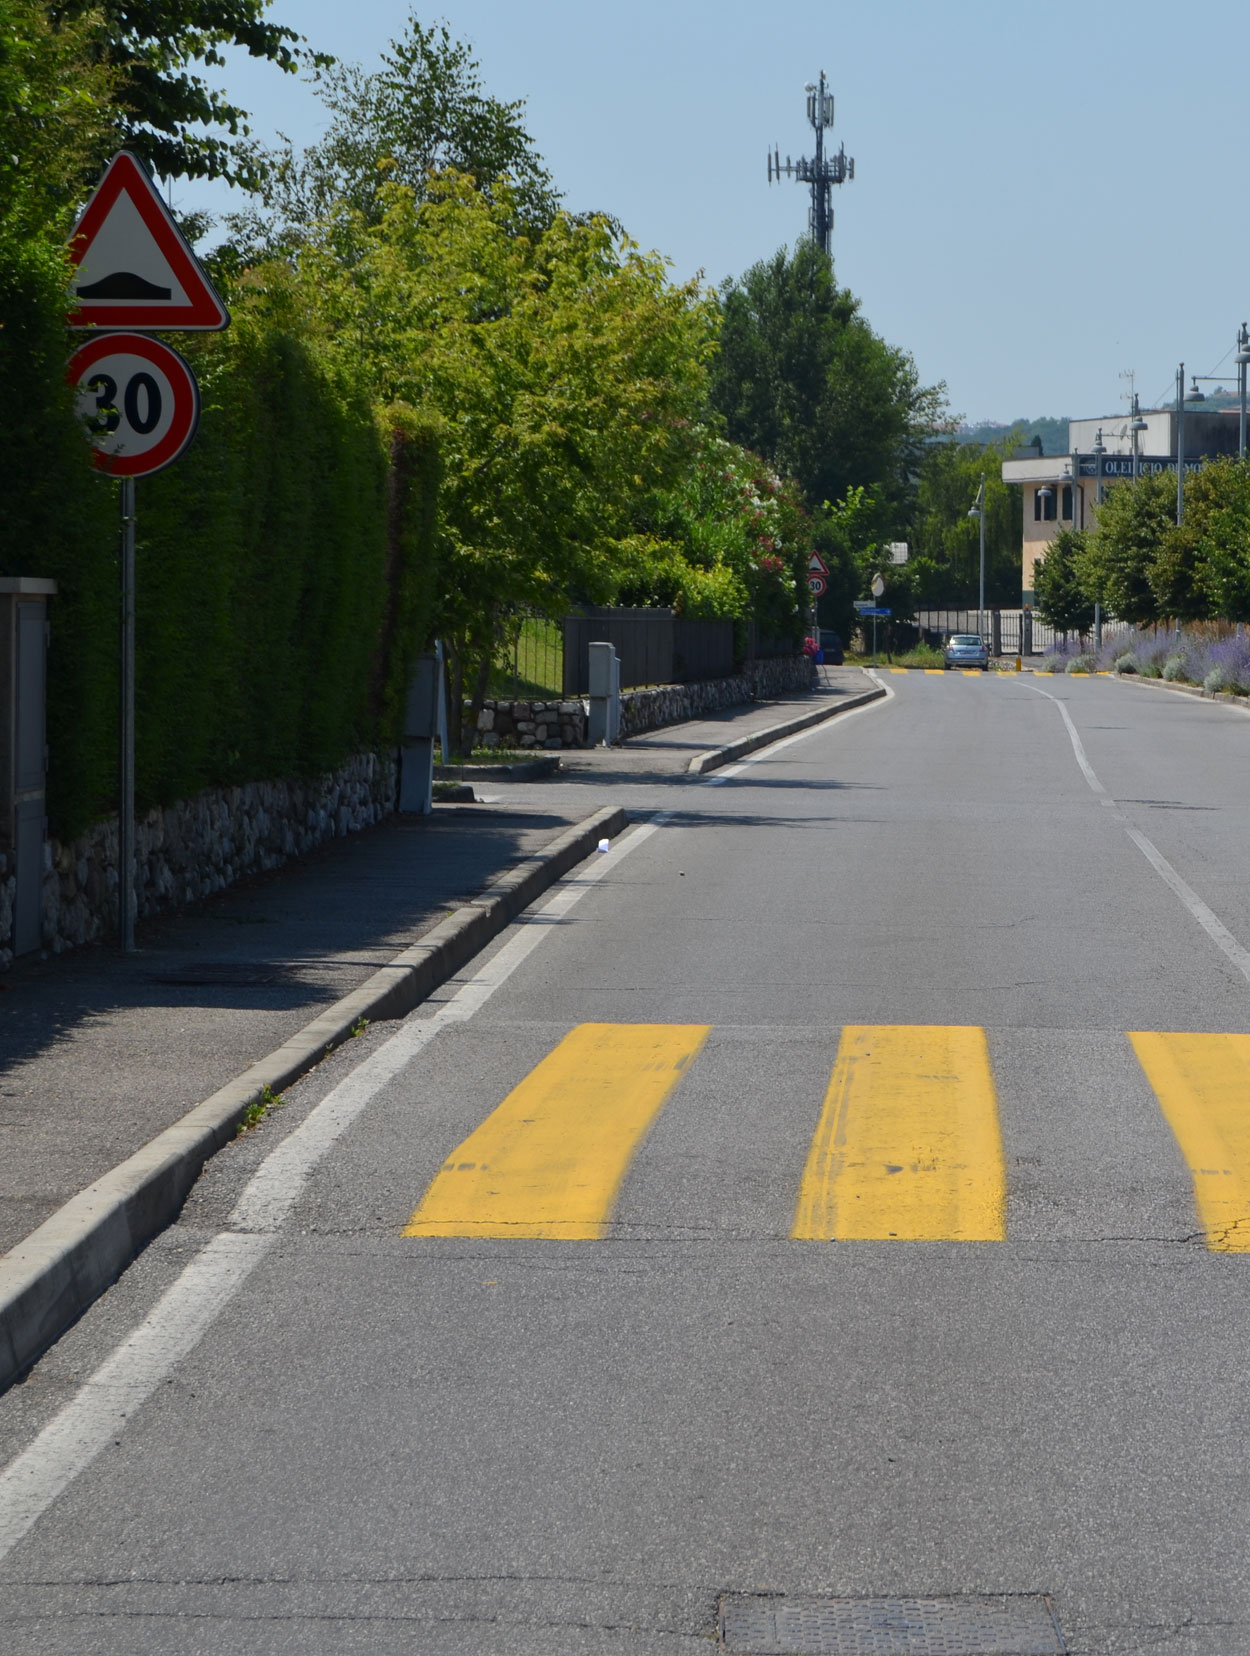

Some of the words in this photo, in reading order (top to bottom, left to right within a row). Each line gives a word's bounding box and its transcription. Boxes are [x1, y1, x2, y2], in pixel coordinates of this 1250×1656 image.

[87, 372, 162, 435] 30
[1105, 461, 1163, 475] OLEIICIO
[810, 580, 821, 591] 30
